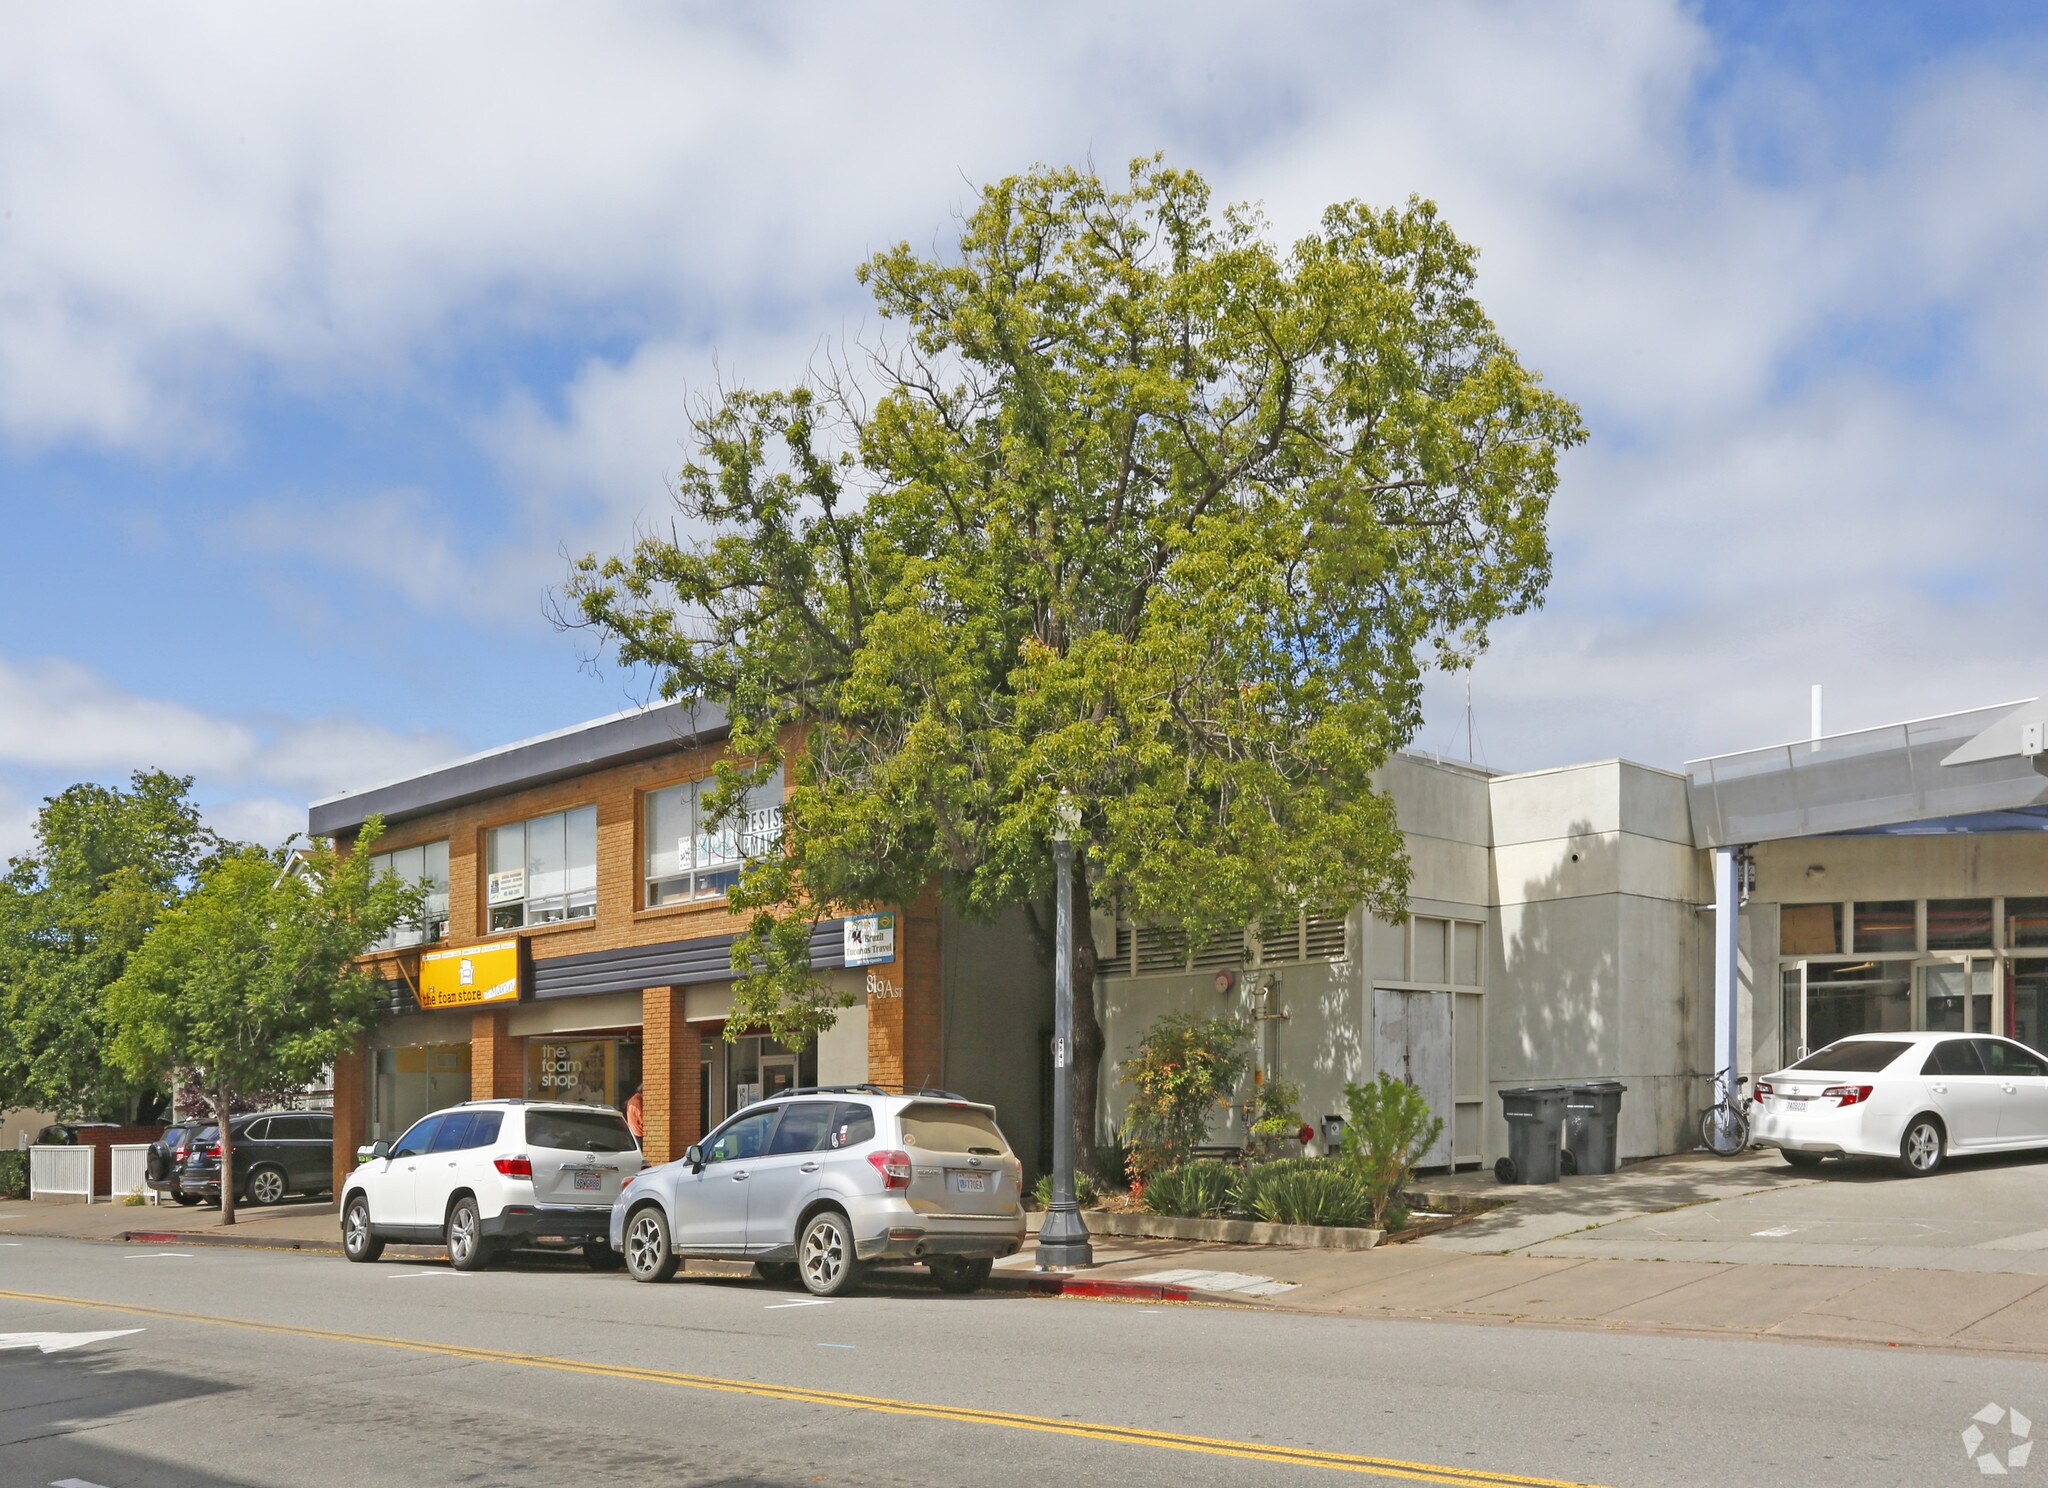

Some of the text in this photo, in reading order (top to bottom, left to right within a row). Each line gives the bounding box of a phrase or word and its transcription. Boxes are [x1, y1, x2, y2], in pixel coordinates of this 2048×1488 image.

[744, 807, 781, 832] RESIS
[864, 933, 884, 942] Brazil
[872, 944, 892, 953] Travel
[423, 993, 436, 1006] the
[438, 991, 457, 1004] foam
[458, 989, 482, 1002] store
[542, 1044, 567, 1058] the
[542, 1058, 582, 1072] foam
[541, 1073, 579, 1089] shop
